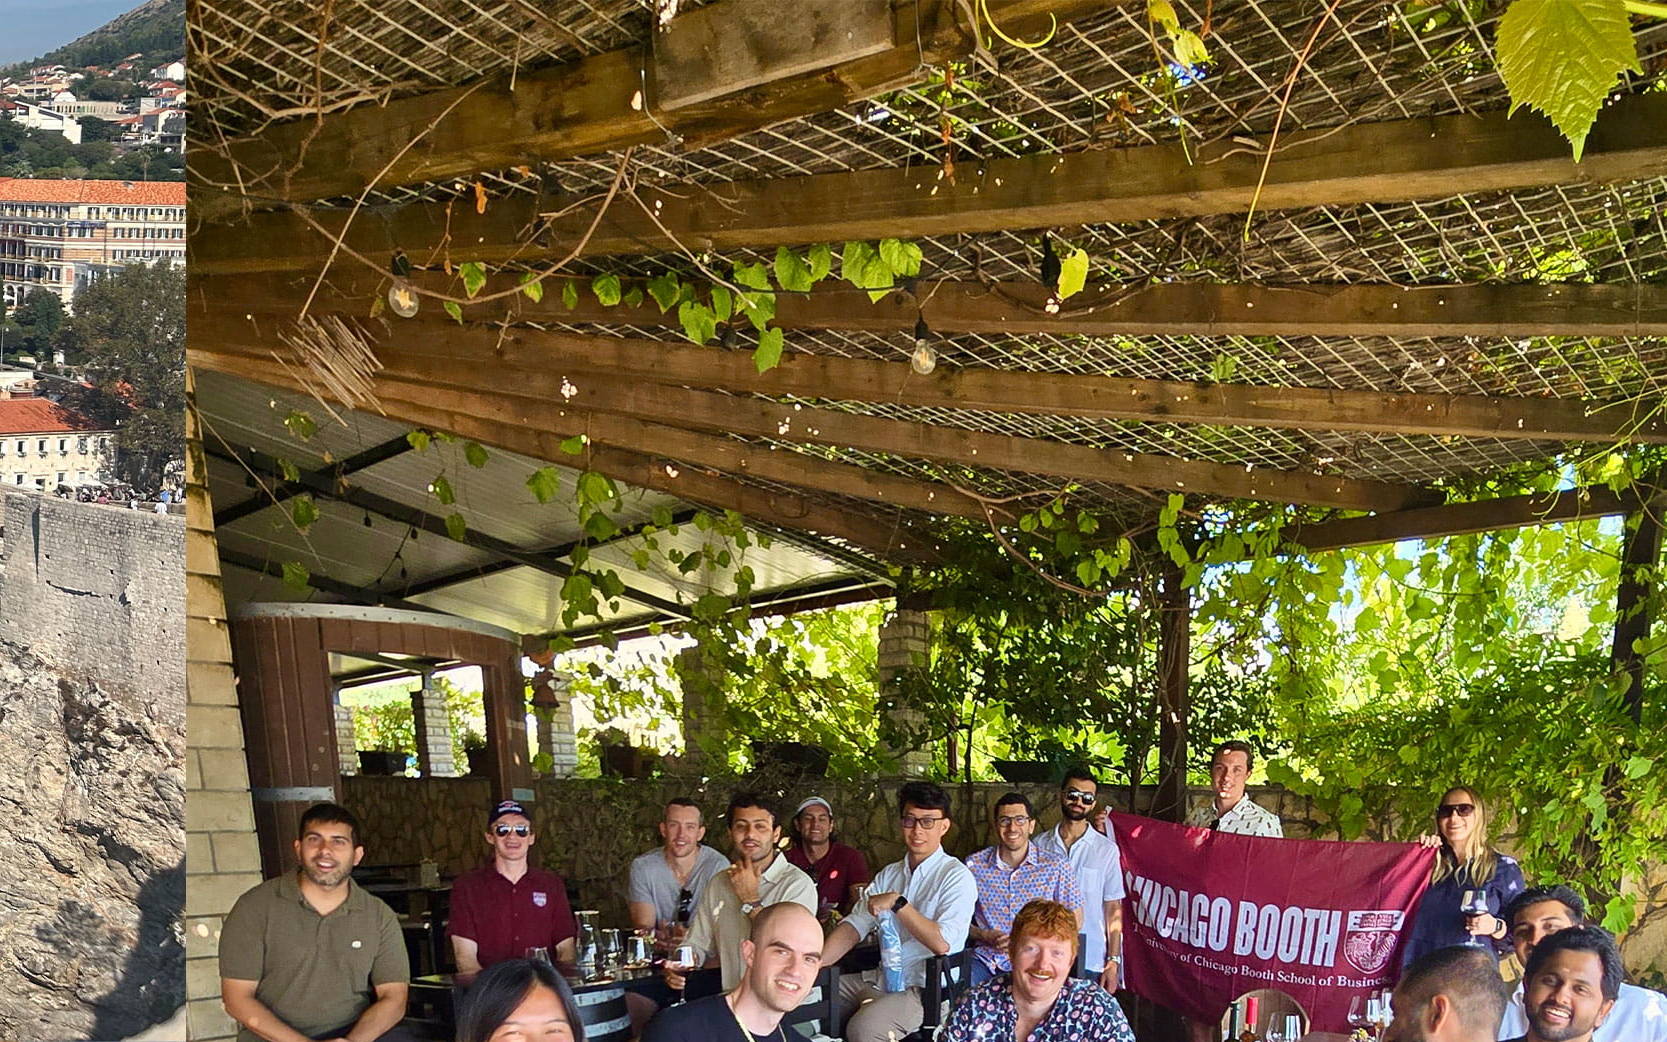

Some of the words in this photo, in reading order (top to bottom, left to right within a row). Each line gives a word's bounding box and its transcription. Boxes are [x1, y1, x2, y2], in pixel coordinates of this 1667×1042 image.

[1233, 901, 1342, 967] BOOTH
[1180, 953, 1192, 963] of
[1194, 955, 1238, 976] Chicago
[1241, 966, 1274, 981] Booth
[1277, 971, 1316, 986] School
[1318, 975, 1334, 987] of
[1337, 975, 1393, 988] Busines
